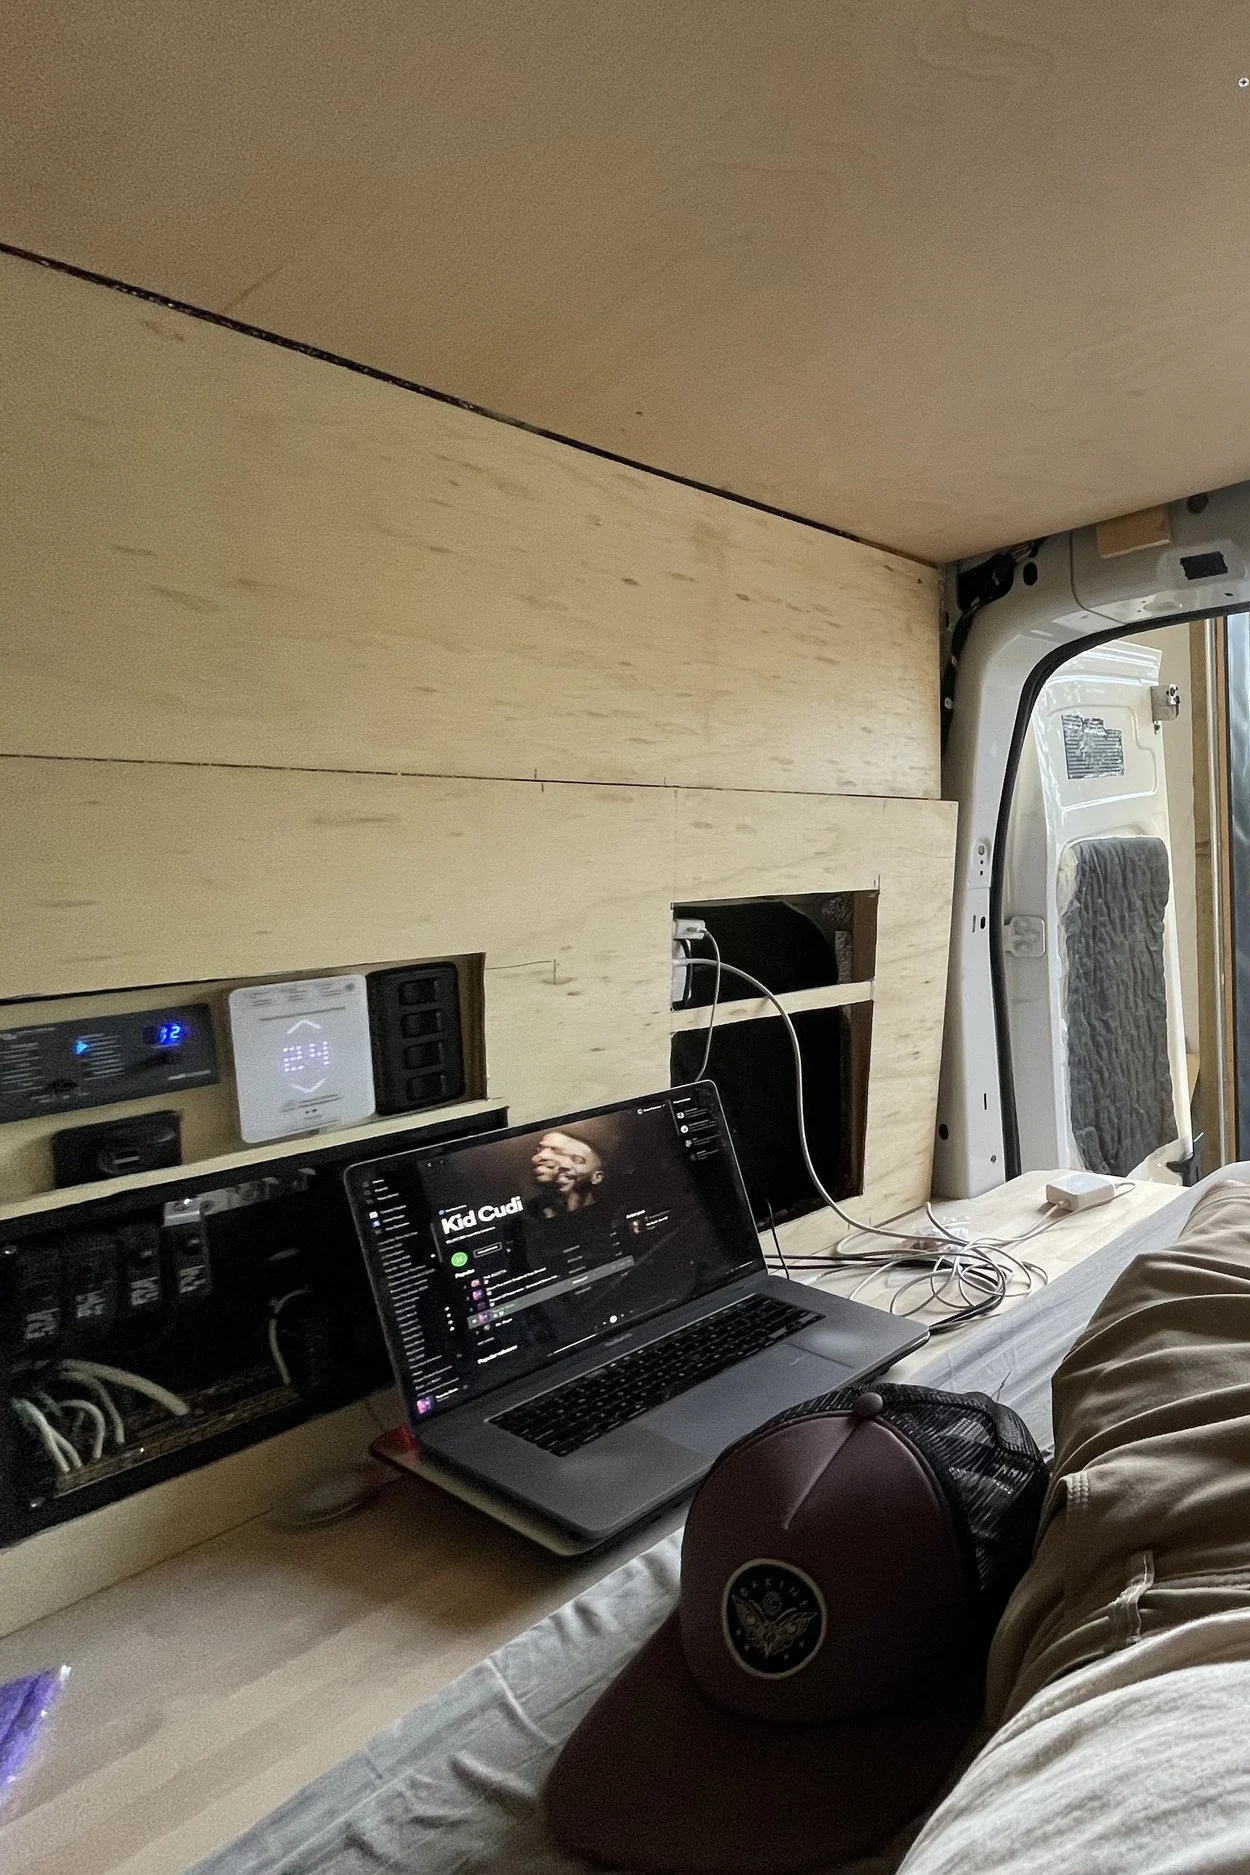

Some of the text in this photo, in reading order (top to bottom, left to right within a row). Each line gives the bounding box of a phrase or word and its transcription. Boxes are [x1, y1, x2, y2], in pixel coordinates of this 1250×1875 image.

[283, 1041, 330, 1072] 24
[441, 1195, 524, 1235] Kid Cudi
